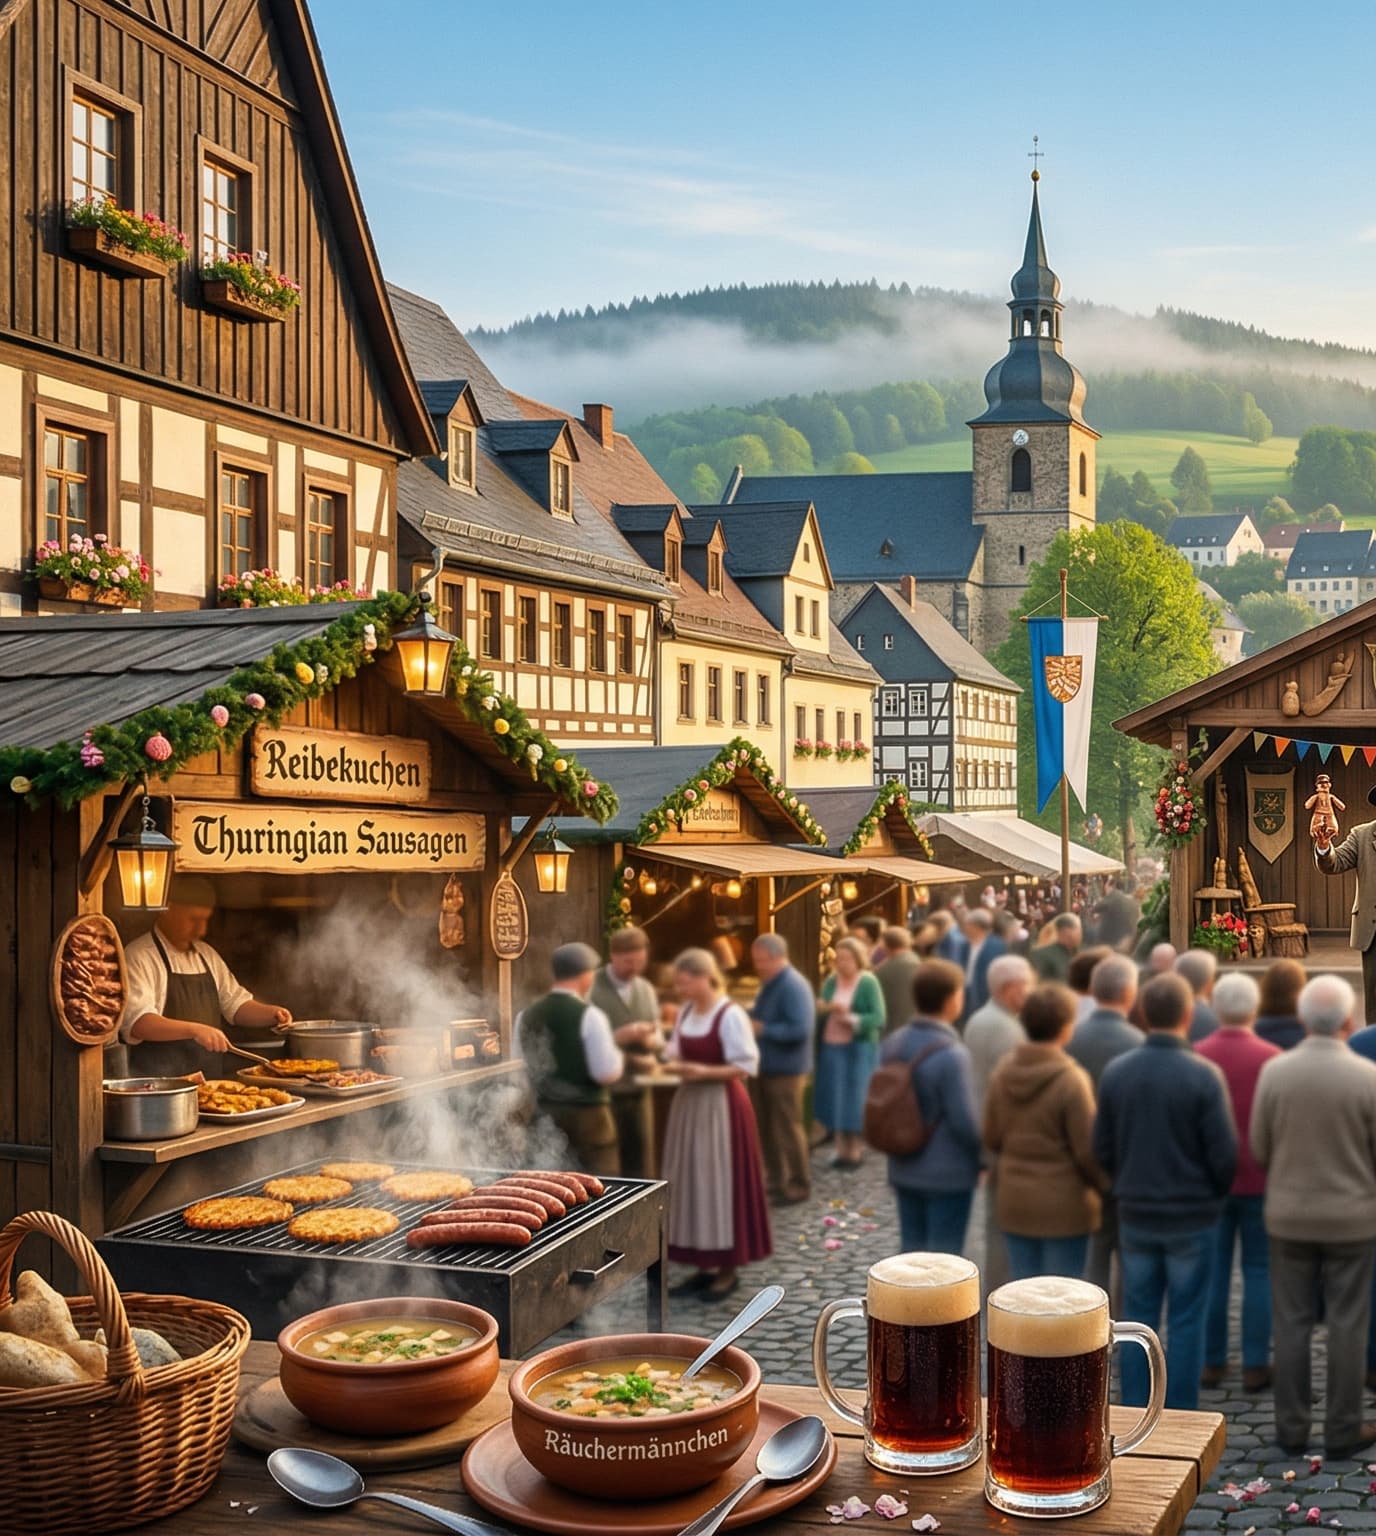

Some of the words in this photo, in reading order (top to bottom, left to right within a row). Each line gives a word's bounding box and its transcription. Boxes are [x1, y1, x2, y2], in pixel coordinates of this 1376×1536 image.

[262, 738, 421, 791] Reibekuchen
[192, 814, 348, 863] Thuringian
[357, 819, 468, 862] Sausagen
[544, 1428, 728, 1461] Räuchermännchen
